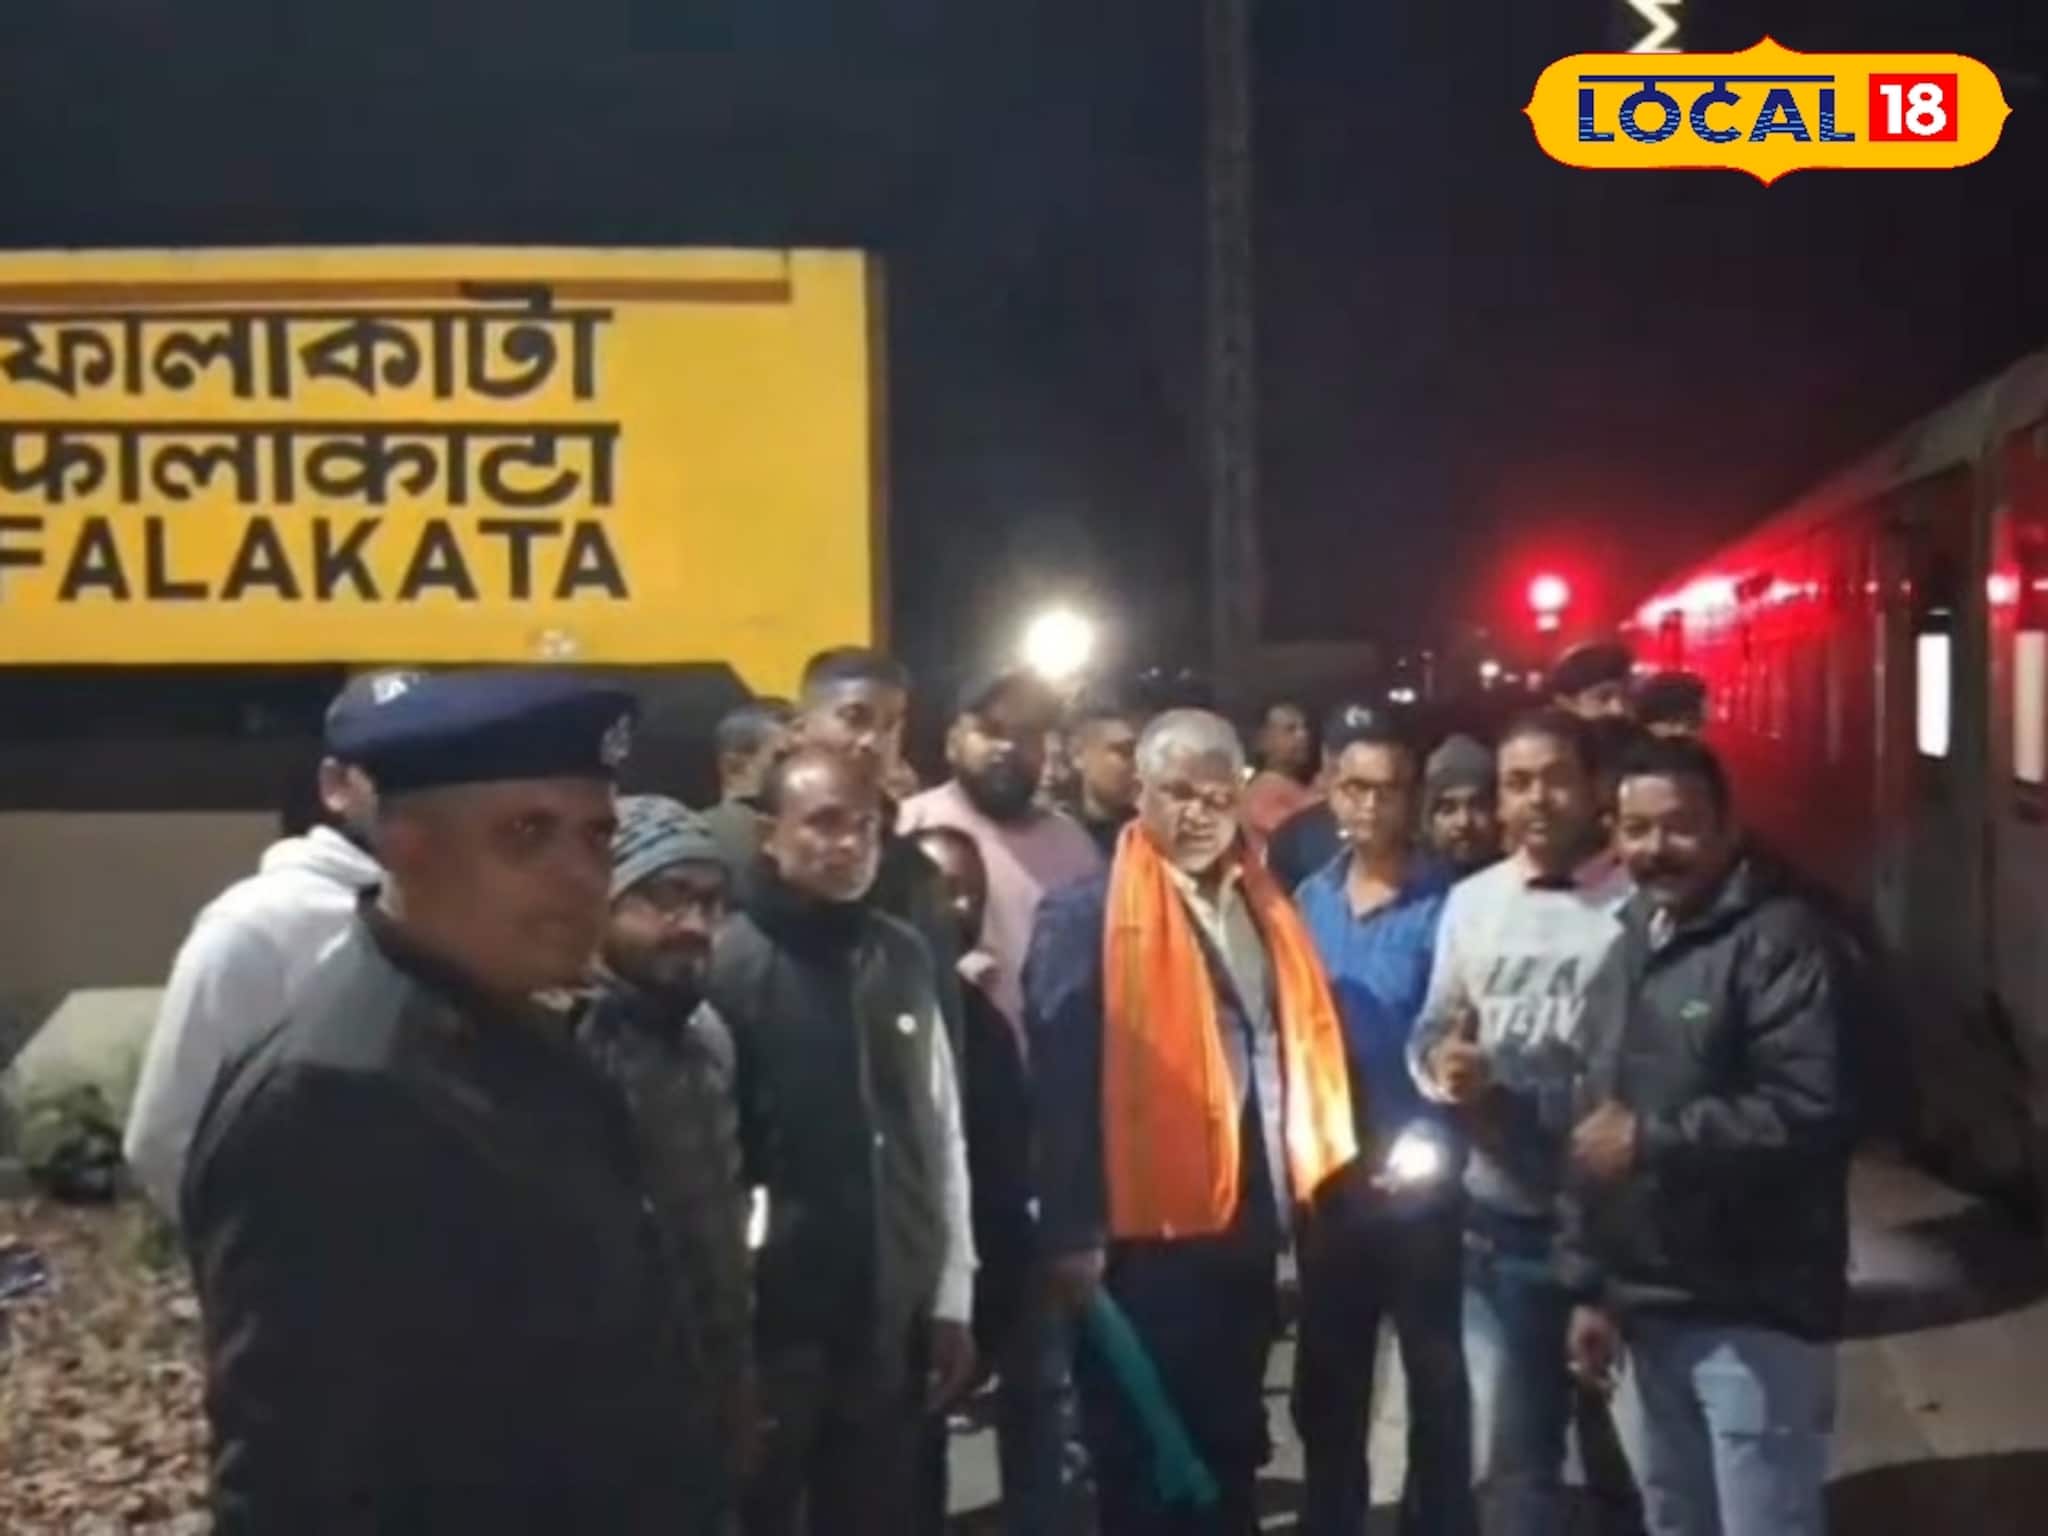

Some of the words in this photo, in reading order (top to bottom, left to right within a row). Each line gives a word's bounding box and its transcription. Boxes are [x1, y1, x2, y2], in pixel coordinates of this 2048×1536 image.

[0, 280, 614, 399] ফালাকাটা
[0, 420, 620, 507] फालाकाटा
[0, 516, 629, 601] FALAKATA
